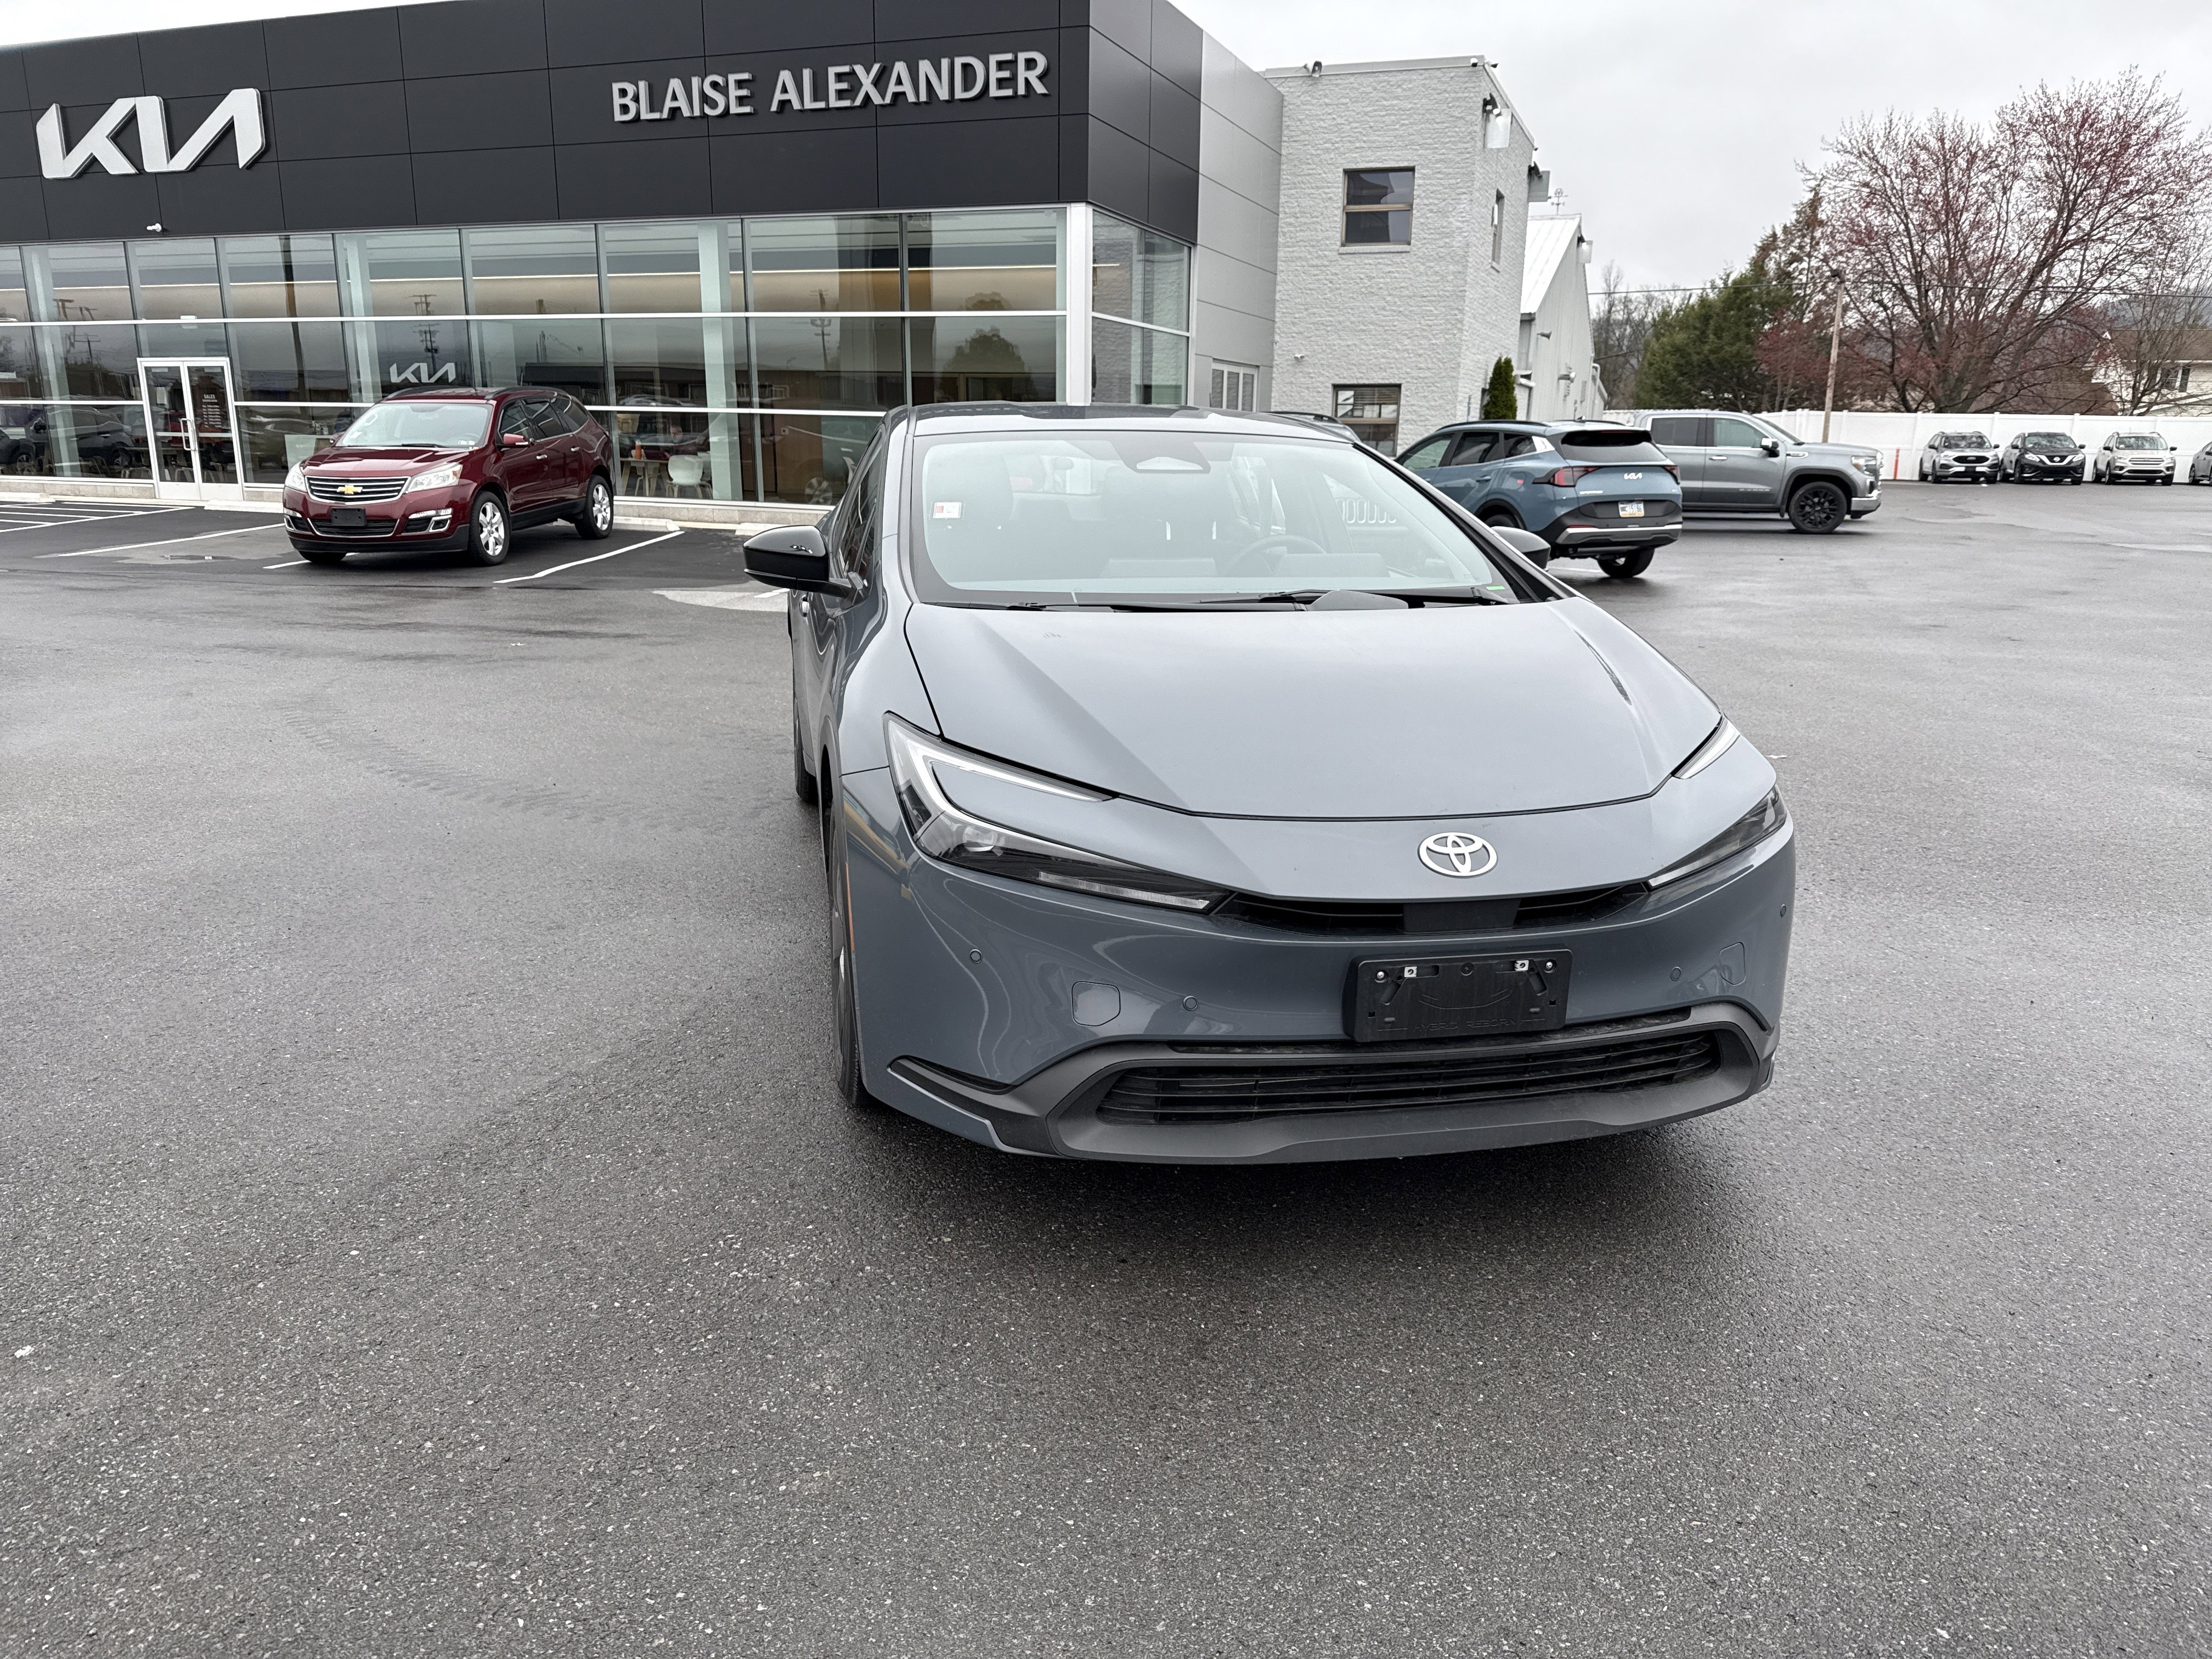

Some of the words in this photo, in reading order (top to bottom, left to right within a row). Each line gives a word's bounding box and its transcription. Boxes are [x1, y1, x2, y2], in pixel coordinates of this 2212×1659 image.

[612, 72, 754, 122] BLAISE
[770, 50, 1049, 112] ALEXANDER
[36, 88, 266, 179] KIA
[390, 362, 456, 383] KIA
